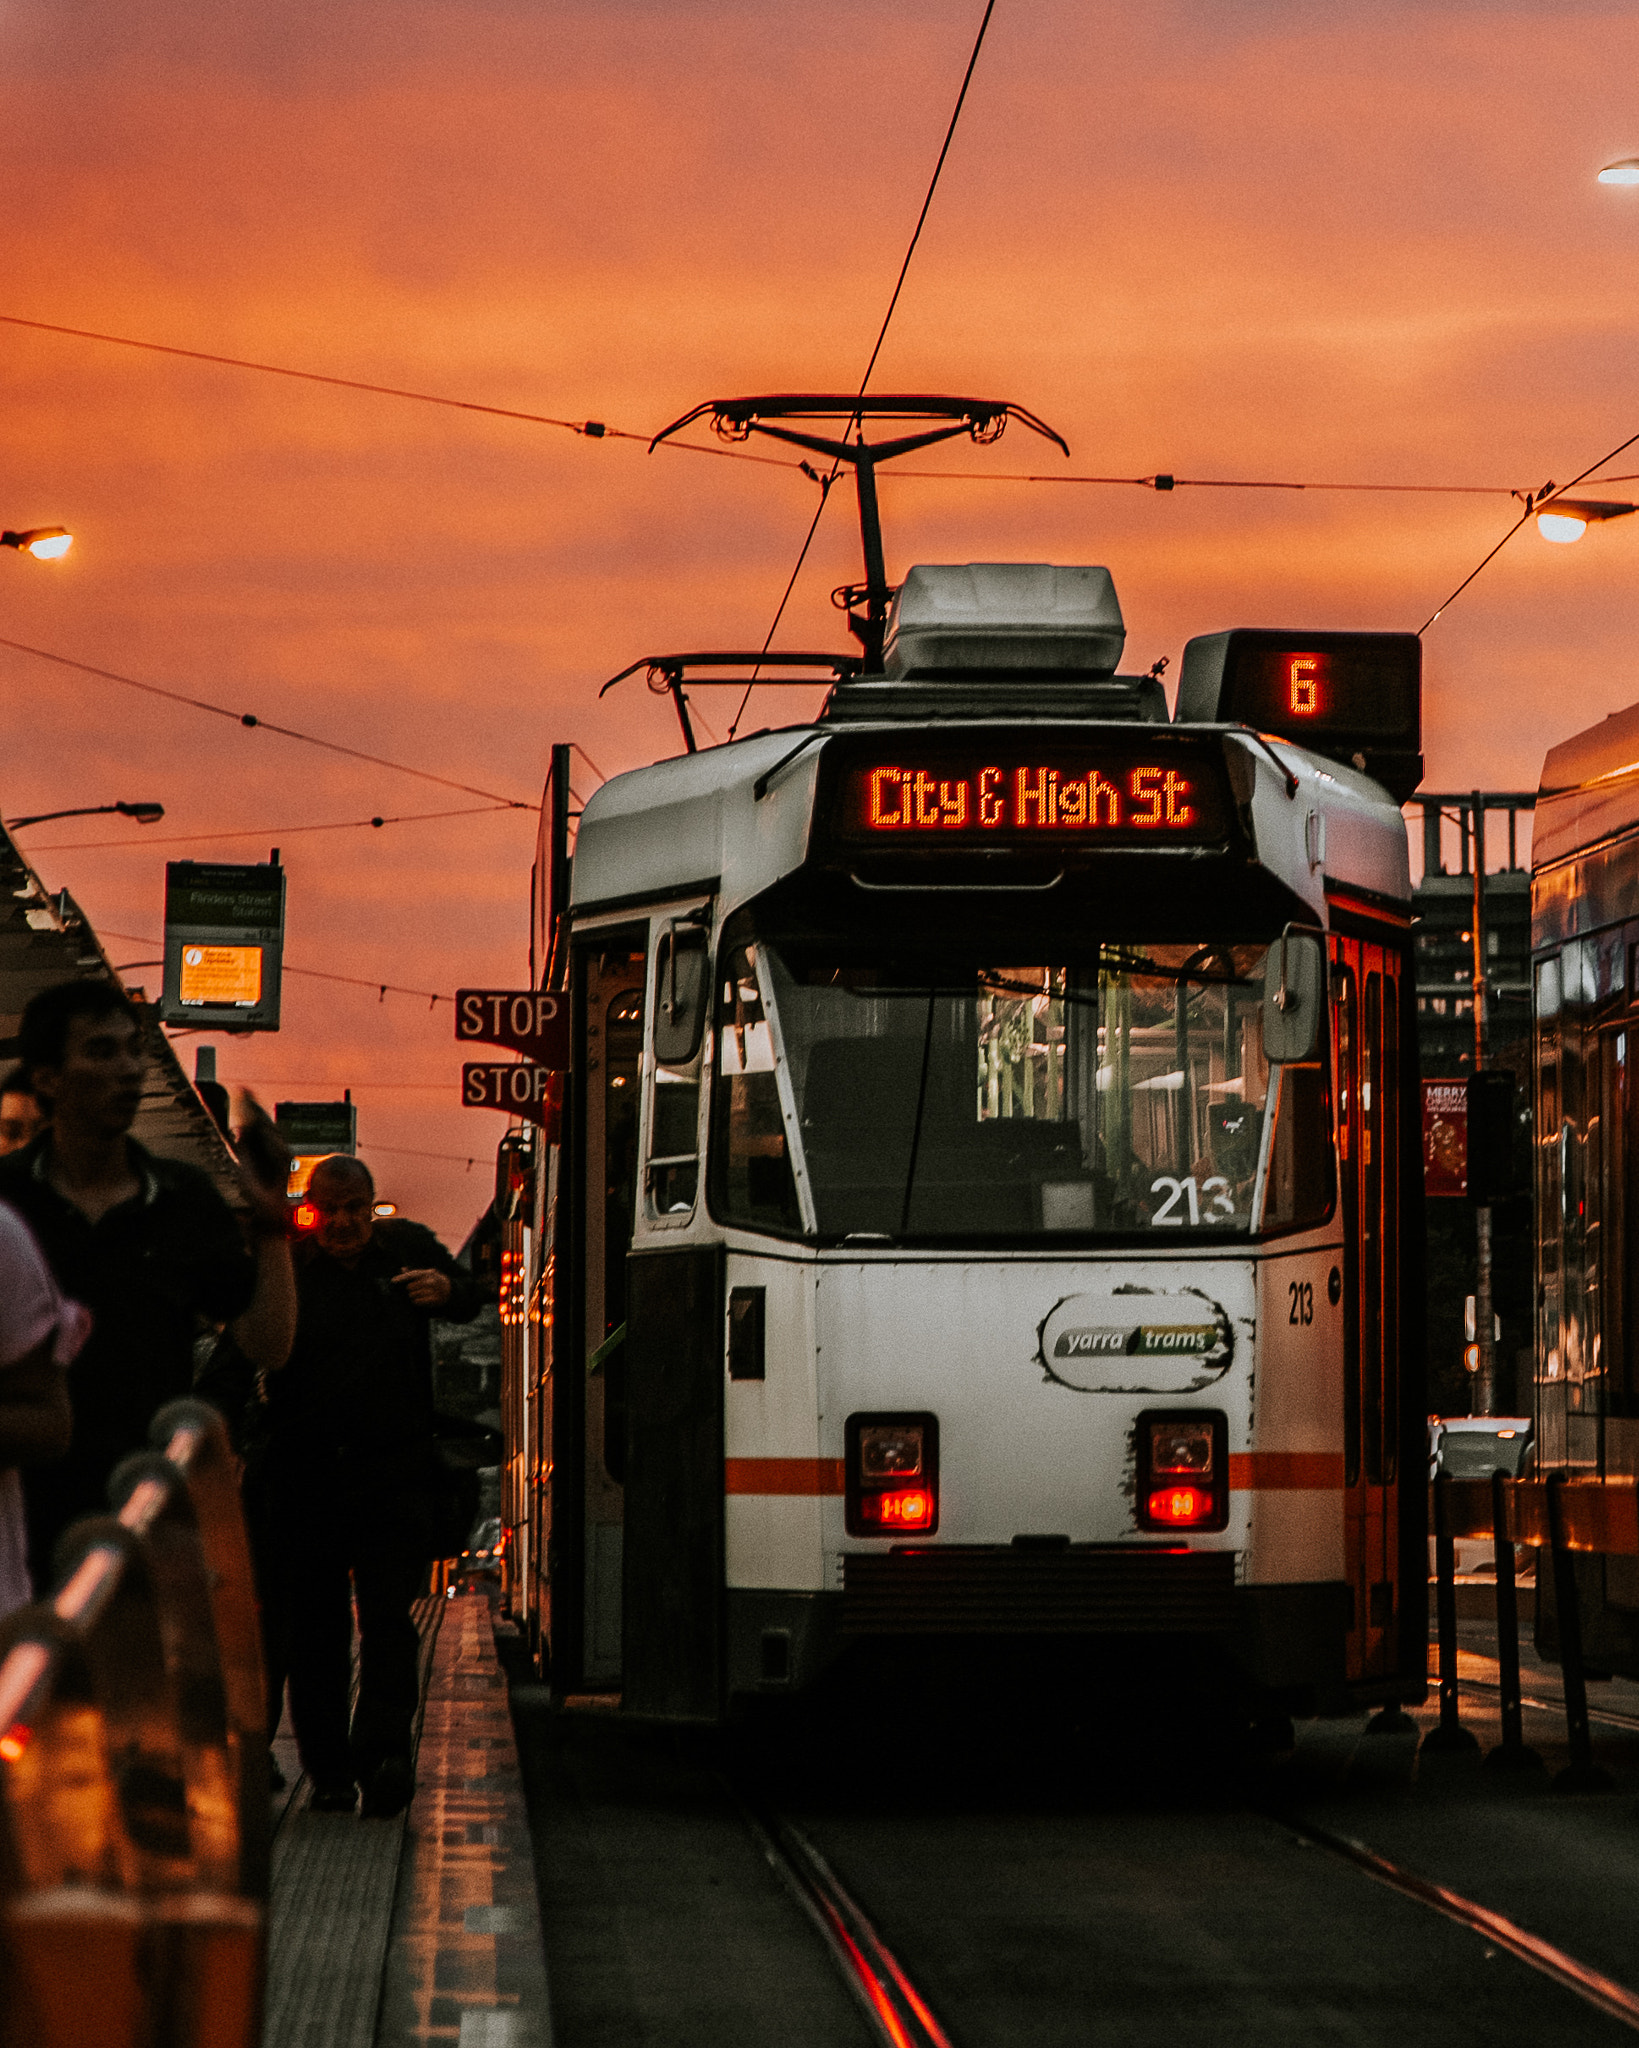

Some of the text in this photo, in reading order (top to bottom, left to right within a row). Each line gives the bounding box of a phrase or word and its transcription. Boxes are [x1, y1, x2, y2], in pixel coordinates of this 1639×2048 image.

[1290, 659, 1317, 713] 6
[871, 767, 1190, 826] City & High St
[461, 995, 558, 1037] STOP
[467, 1067, 550, 1103] STOP
[1426, 1086, 1468, 1097] MERRY
[1150, 1176, 1235, 1226] 213
[1288, 1281, 1314, 1327] 213
[1067, 1331, 1206, 1354] yarra trams
